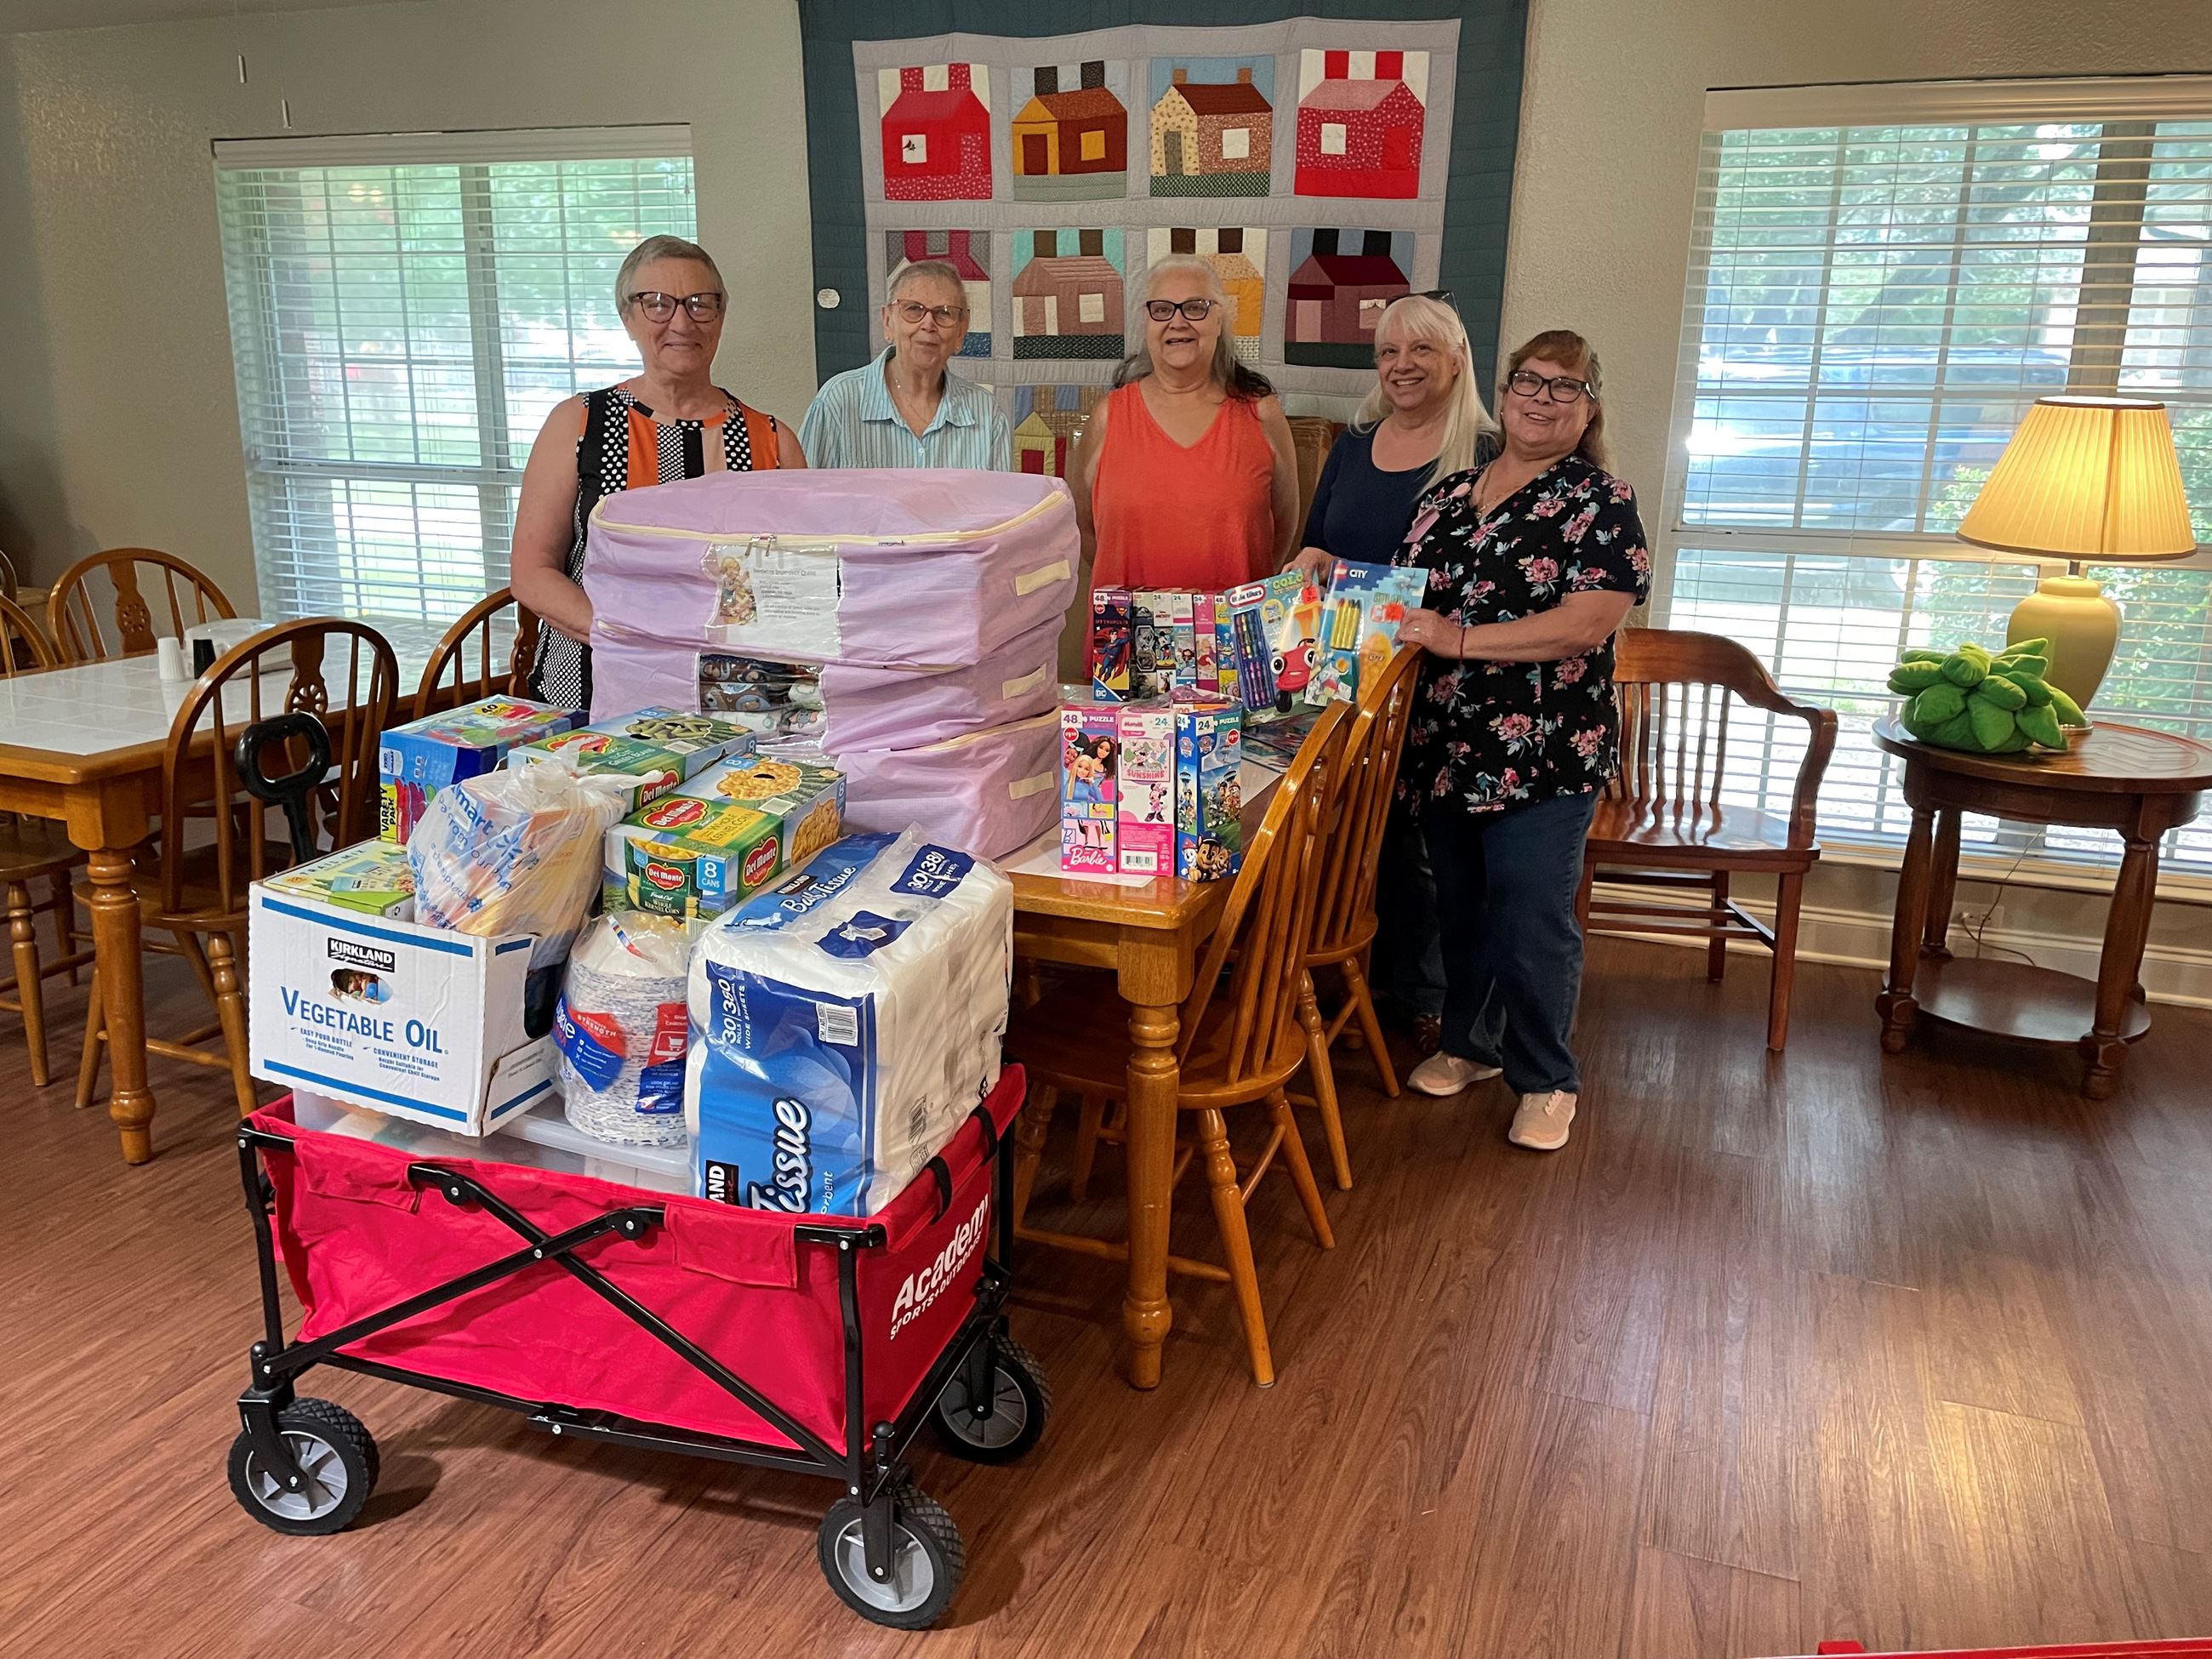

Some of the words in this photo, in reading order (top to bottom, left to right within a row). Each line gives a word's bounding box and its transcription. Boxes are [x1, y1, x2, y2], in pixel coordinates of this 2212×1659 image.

[1349, 569, 1368, 579] CITY
[1096, 688, 1106, 698] DC
[482, 704, 498, 715] 40
[1063, 714, 1078, 723] 48
[1155, 717, 1168, 726] 24
[1198, 721, 1211, 731] 24
[749, 739, 755, 753] 8
[1127, 768, 1166, 779] SUNSHINE
[643, 786, 654, 801] Del
[655, 780, 677, 797] Monte
[838, 782, 845, 796] 8
[653, 812, 672, 827] Del
[671, 800, 698, 818] Monte
[745, 861, 755, 873] Del
[756, 846, 776, 866] Monte
[1070, 846, 1108, 866] Barbie
[648, 868, 659, 878] Del
[660, 872, 682, 882] Monte
[704, 862, 718, 878] 8
[807, 866, 857, 894] Tissue
[702, 878, 720, 889] CANS
[907, 873, 928, 889] 30
[653, 898, 671, 908] WHOLE
[330, 939, 393, 965] KIRKLAND
[330, 951, 393, 971] Signature
[718, 978, 738, 1015] 380
[739, 984, 750, 1022] SHEETS
[281, 985, 395, 1043] VEGETABLE
[405, 1019, 443, 1055] OIL
[578, 1014, 617, 1037] STRENGTH
[300, 1028, 314, 1037] EASY
[315, 1031, 330, 1042] POUR
[332, 1036, 353, 1048] BOTTLE
[722, 1018, 738, 1044] 30
[744, 1023, 752, 1050] WIDE
[373, 1047, 411, 1062] CONVENIENT
[412, 1056, 439, 1069] STORAGE
[379, 1063, 408, 1075] Convenient
[421, 1072, 441, 1081] Storage
[751, 1097, 808, 1213] Tissue
[820, 1171, 835, 1216] orbent
